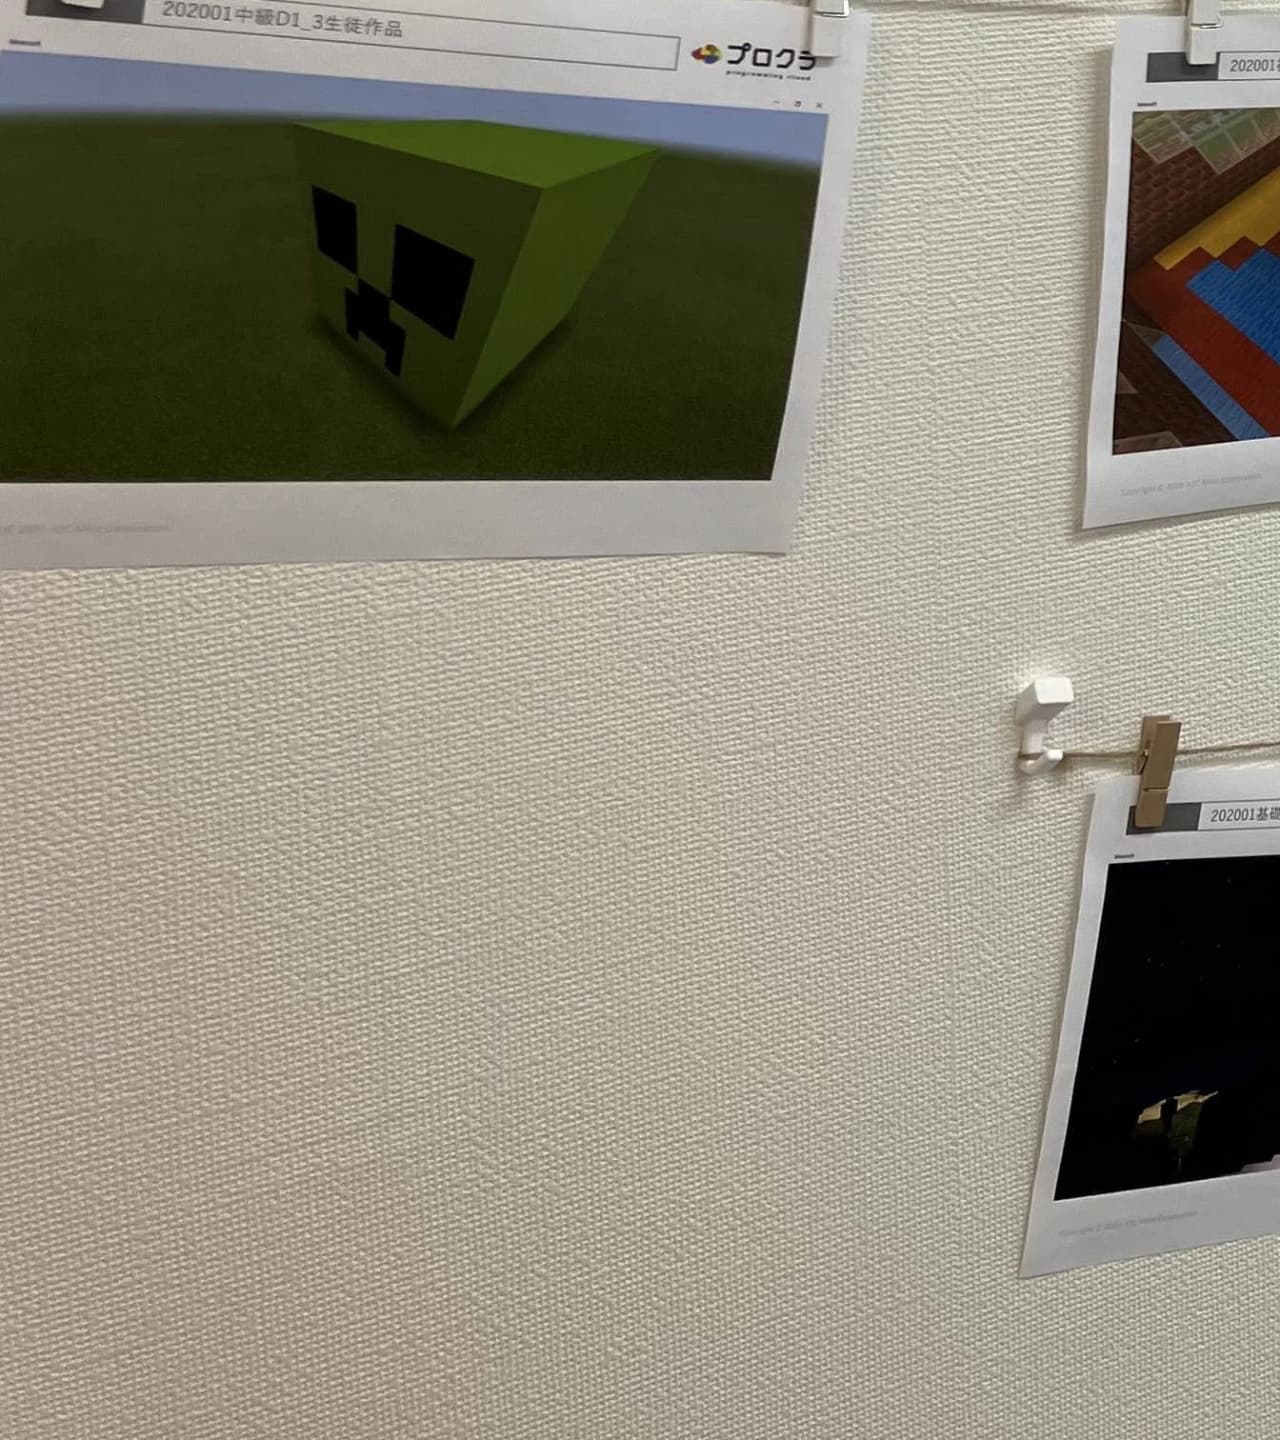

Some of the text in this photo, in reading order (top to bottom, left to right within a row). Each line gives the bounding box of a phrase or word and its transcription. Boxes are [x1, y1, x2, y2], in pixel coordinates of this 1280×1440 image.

[162, 0, 403, 38] 202001中級D1_3生徒作品
